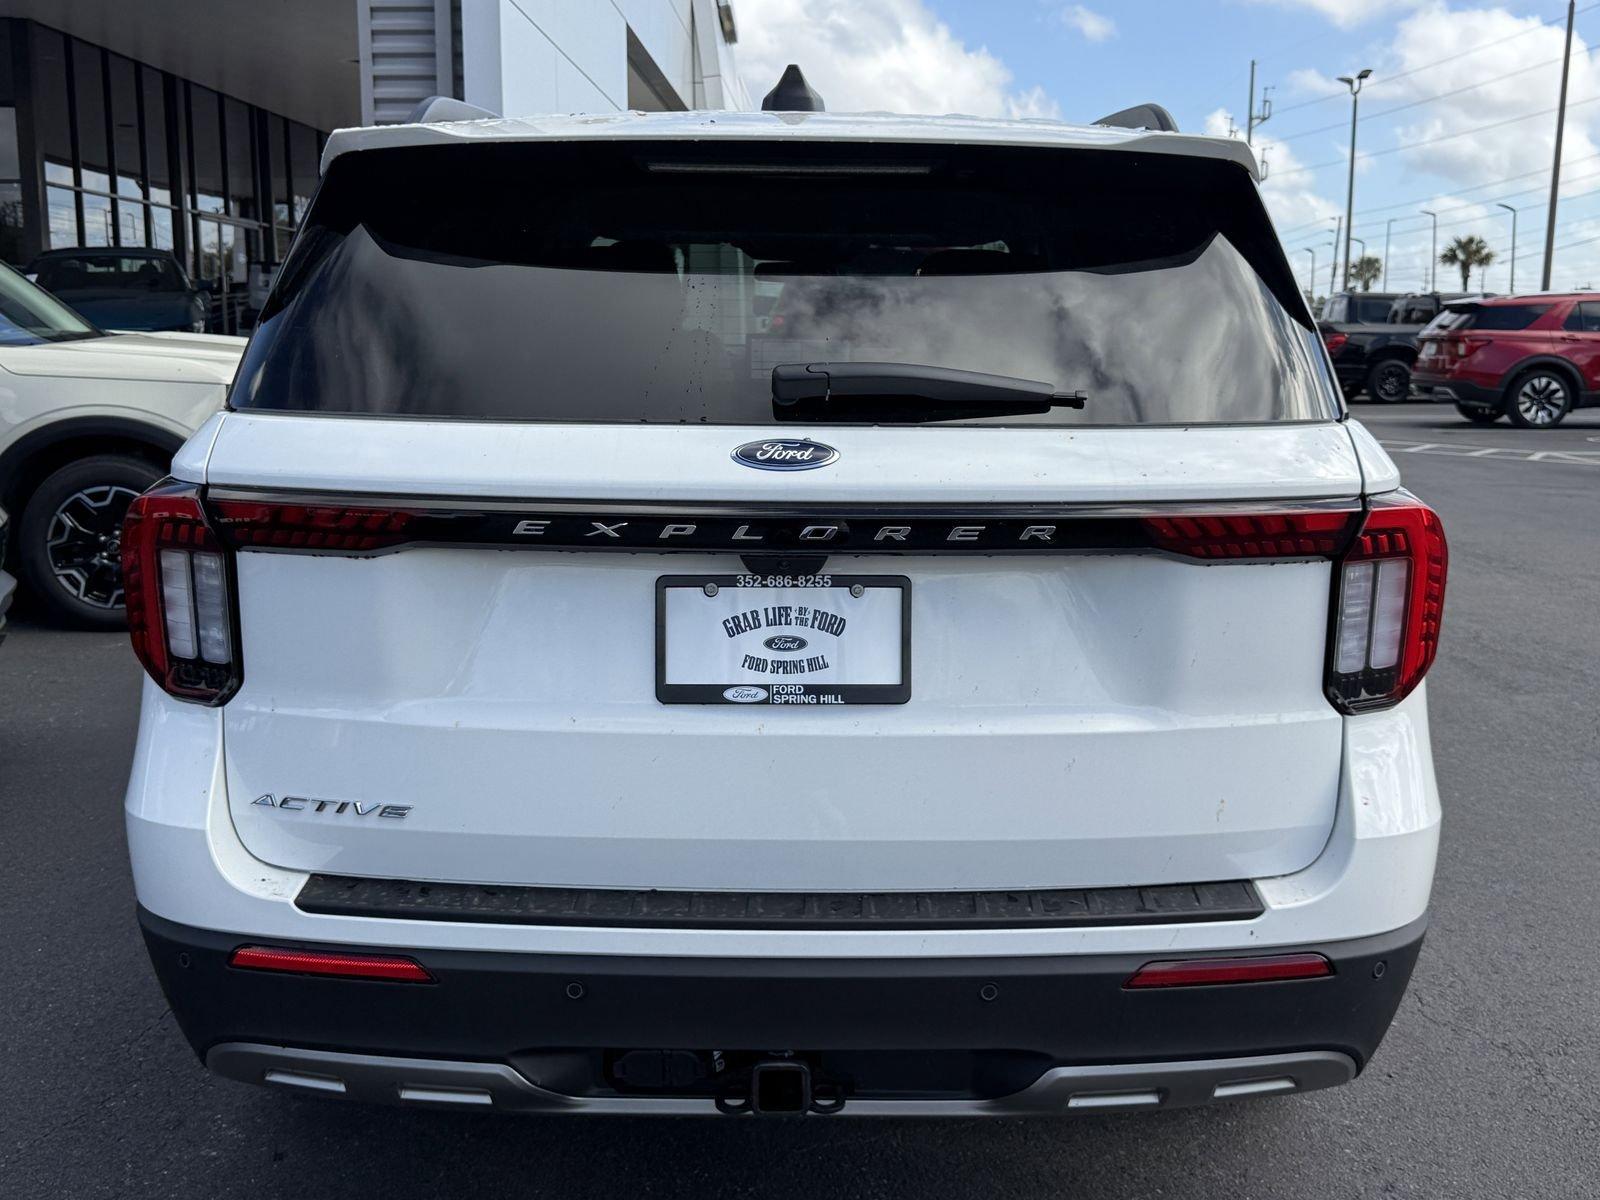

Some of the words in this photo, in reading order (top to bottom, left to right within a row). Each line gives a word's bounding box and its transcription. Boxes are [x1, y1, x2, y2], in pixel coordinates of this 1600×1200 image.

[756, 442, 815, 460] Ford
[512, 520, 1057, 541] EXPLORER
[736, 575, 832, 588] 352-686-8255
[722, 609, 762, 638] GRAB
[764, 606, 793, 627] LIFE
[794, 616, 810, 627] THE
[810, 609, 847, 637] FORD
[771, 638, 800, 649] Ford
[741, 654, 769, 673] FORD
[769, 660, 805, 674] SPRING
[806, 655, 829, 672] HILL
[732, 688, 759, 699] Ford
[773, 685, 804, 694] FORD
[773, 694, 817, 704] SPRING
[820, 694, 845, 704] HILL
[250, 793, 414, 819] ACTIVE
